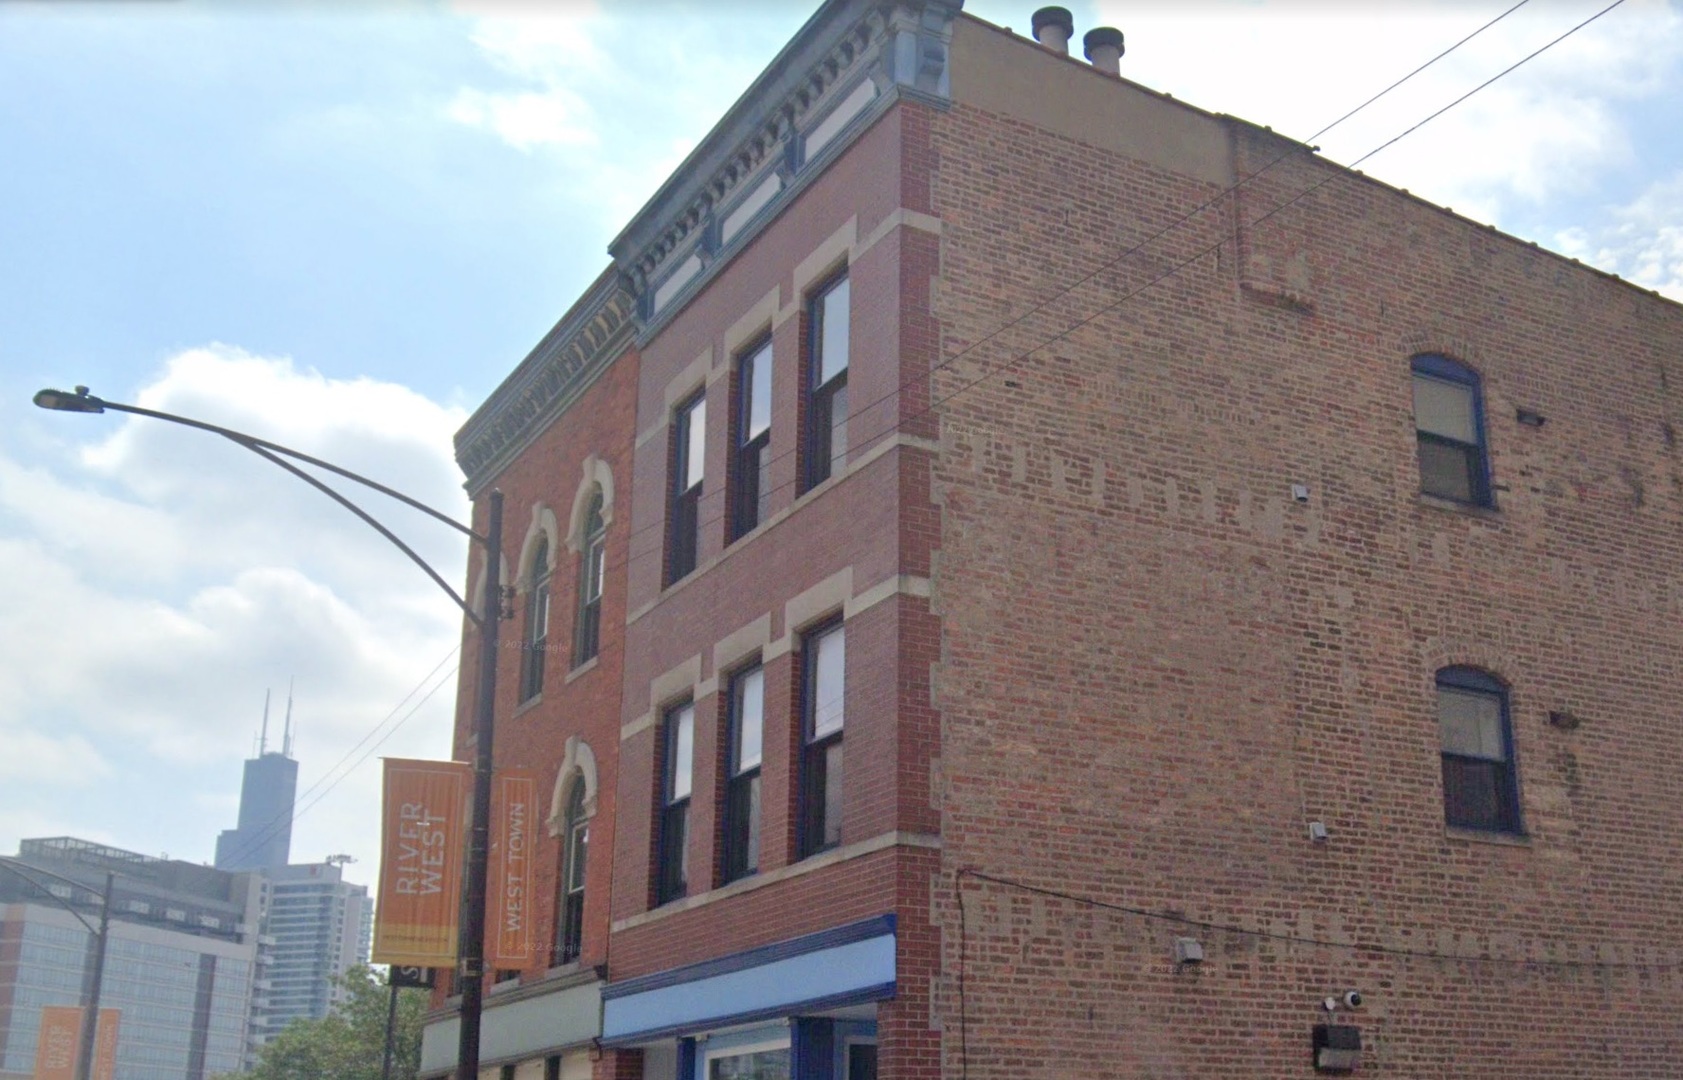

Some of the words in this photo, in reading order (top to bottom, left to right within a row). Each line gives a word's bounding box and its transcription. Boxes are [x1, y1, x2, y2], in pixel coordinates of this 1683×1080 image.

[396, 802, 422, 894] RIVER
[420, 808, 446, 896] WEST
[508, 803, 525, 864] TOWN
[506, 872, 524, 932] WEST
